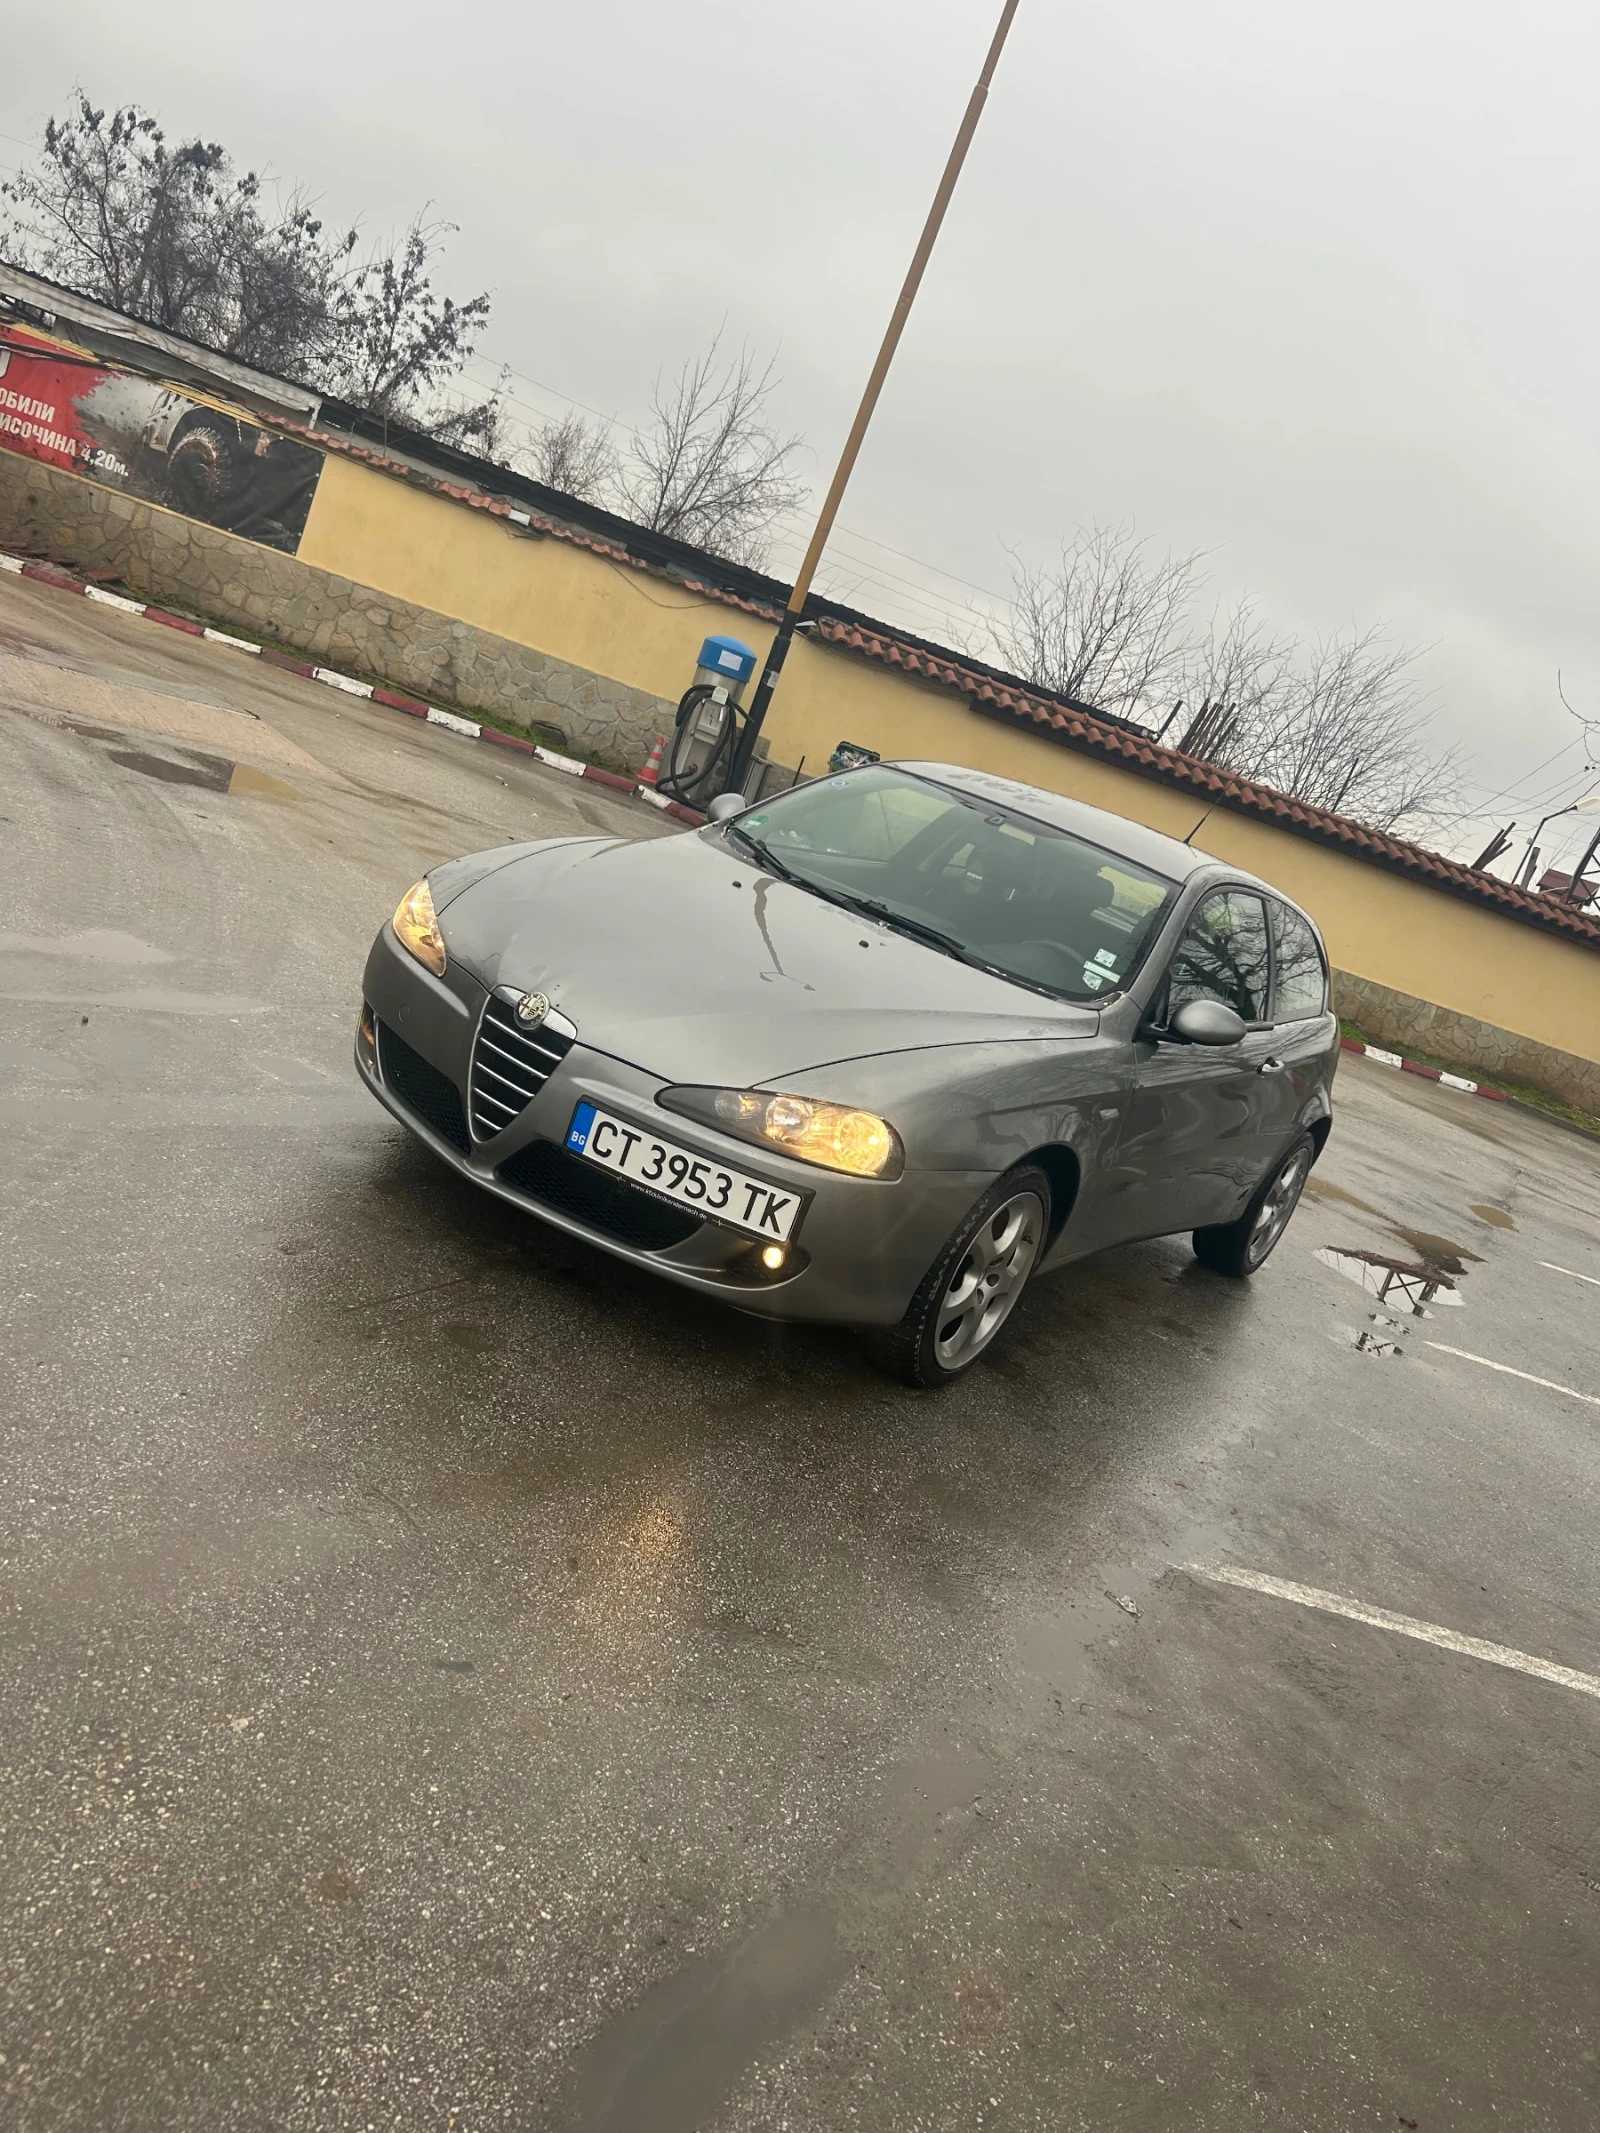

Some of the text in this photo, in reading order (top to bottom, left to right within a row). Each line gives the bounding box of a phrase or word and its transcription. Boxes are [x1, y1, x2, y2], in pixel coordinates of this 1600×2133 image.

[570, 1131, 586, 1146] BG
[592, 1121, 792, 1235] CT 3953 TK
